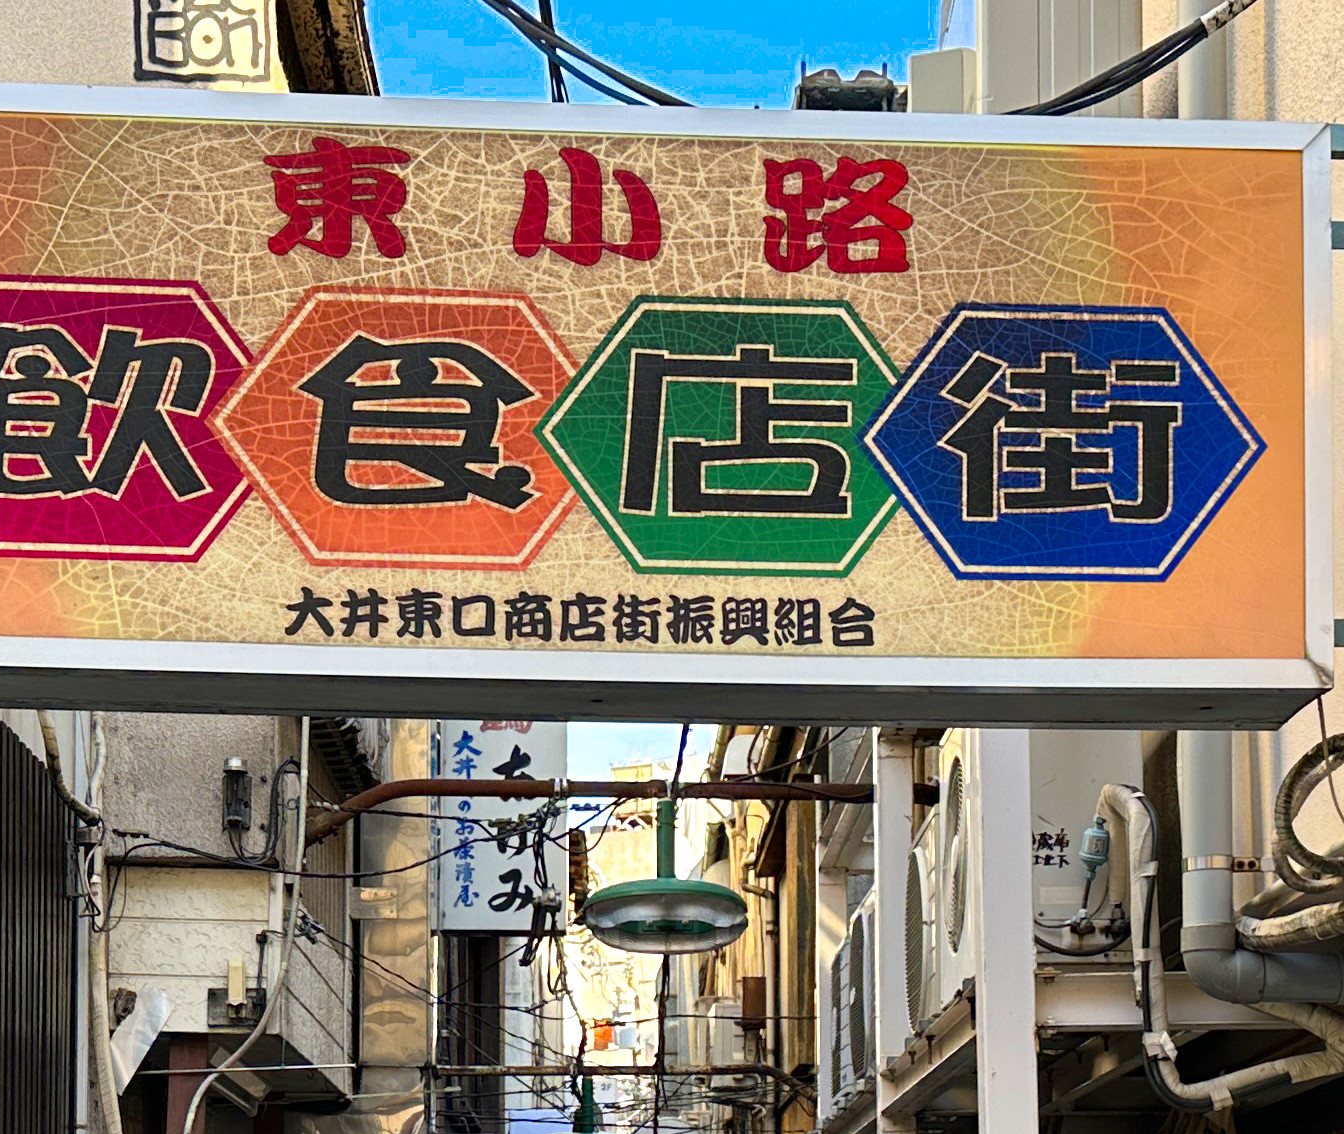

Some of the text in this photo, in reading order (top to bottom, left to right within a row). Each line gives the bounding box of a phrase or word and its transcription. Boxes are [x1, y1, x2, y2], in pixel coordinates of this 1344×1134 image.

[266, 137, 913, 275] 東小路
[285, 587, 876, 650] 大井東口商店街振興組合
[452, 730, 482, 908] 大井のお茶漬屋
